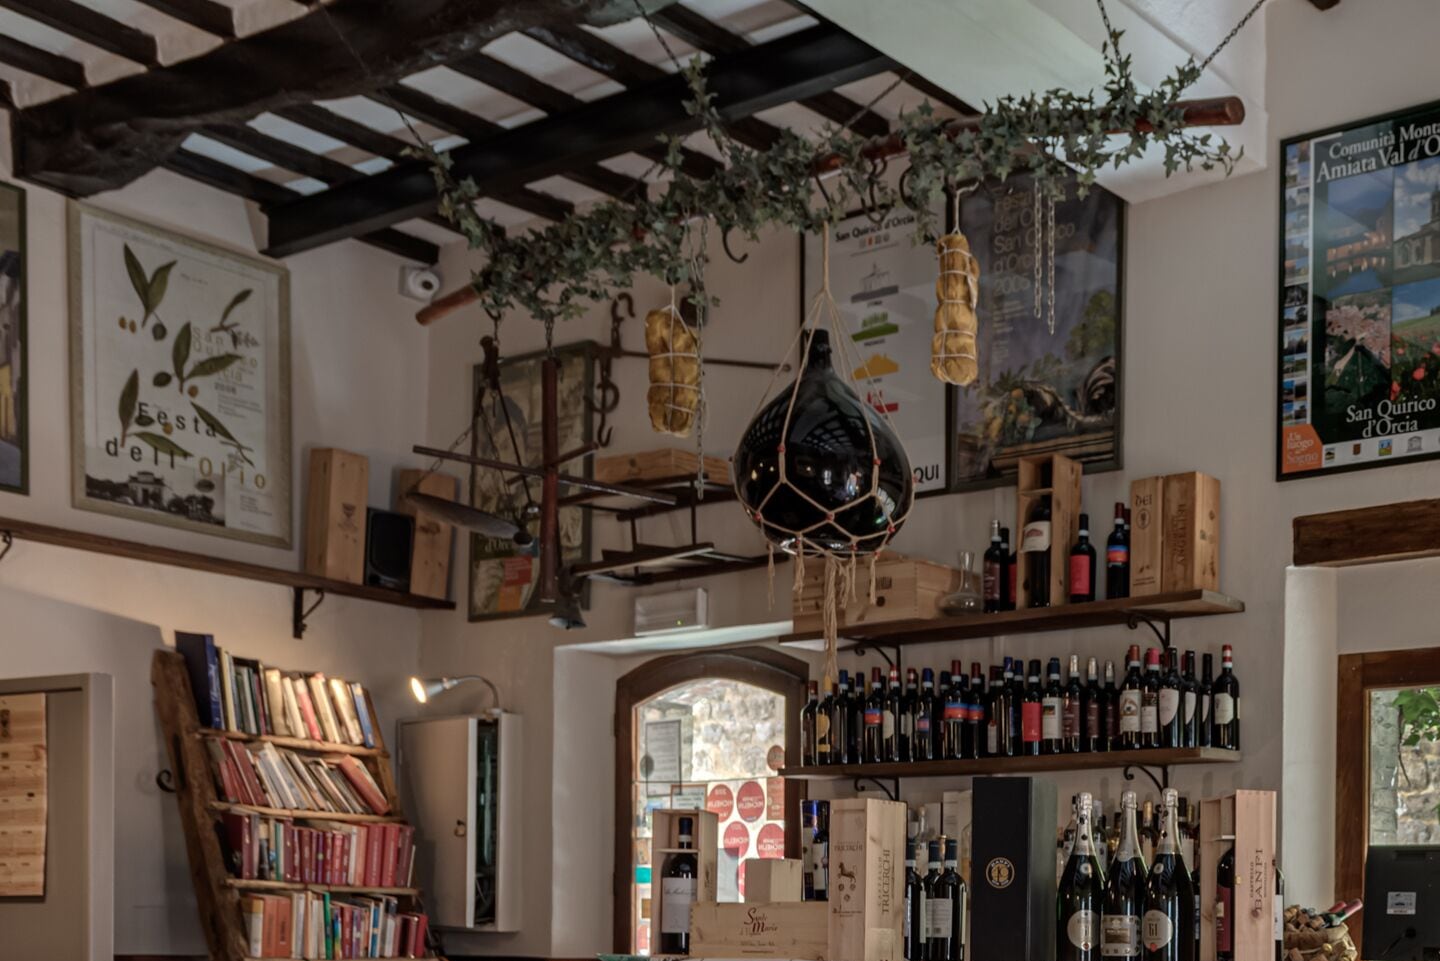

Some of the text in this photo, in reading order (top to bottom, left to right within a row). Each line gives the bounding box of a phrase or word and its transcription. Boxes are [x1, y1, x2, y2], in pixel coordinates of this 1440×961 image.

[1316, 156, 1377, 183] Amiata
[1378, 143, 1406, 168] Val
[1329, 131, 1396, 160] Comunità
[1346, 394, 1437, 424] San Quirico
[1361, 415, 1419, 439] d'Orcia
[882, 849, 891, 915] TRICERCHI
[1255, 848, 1264, 913] BANFI
